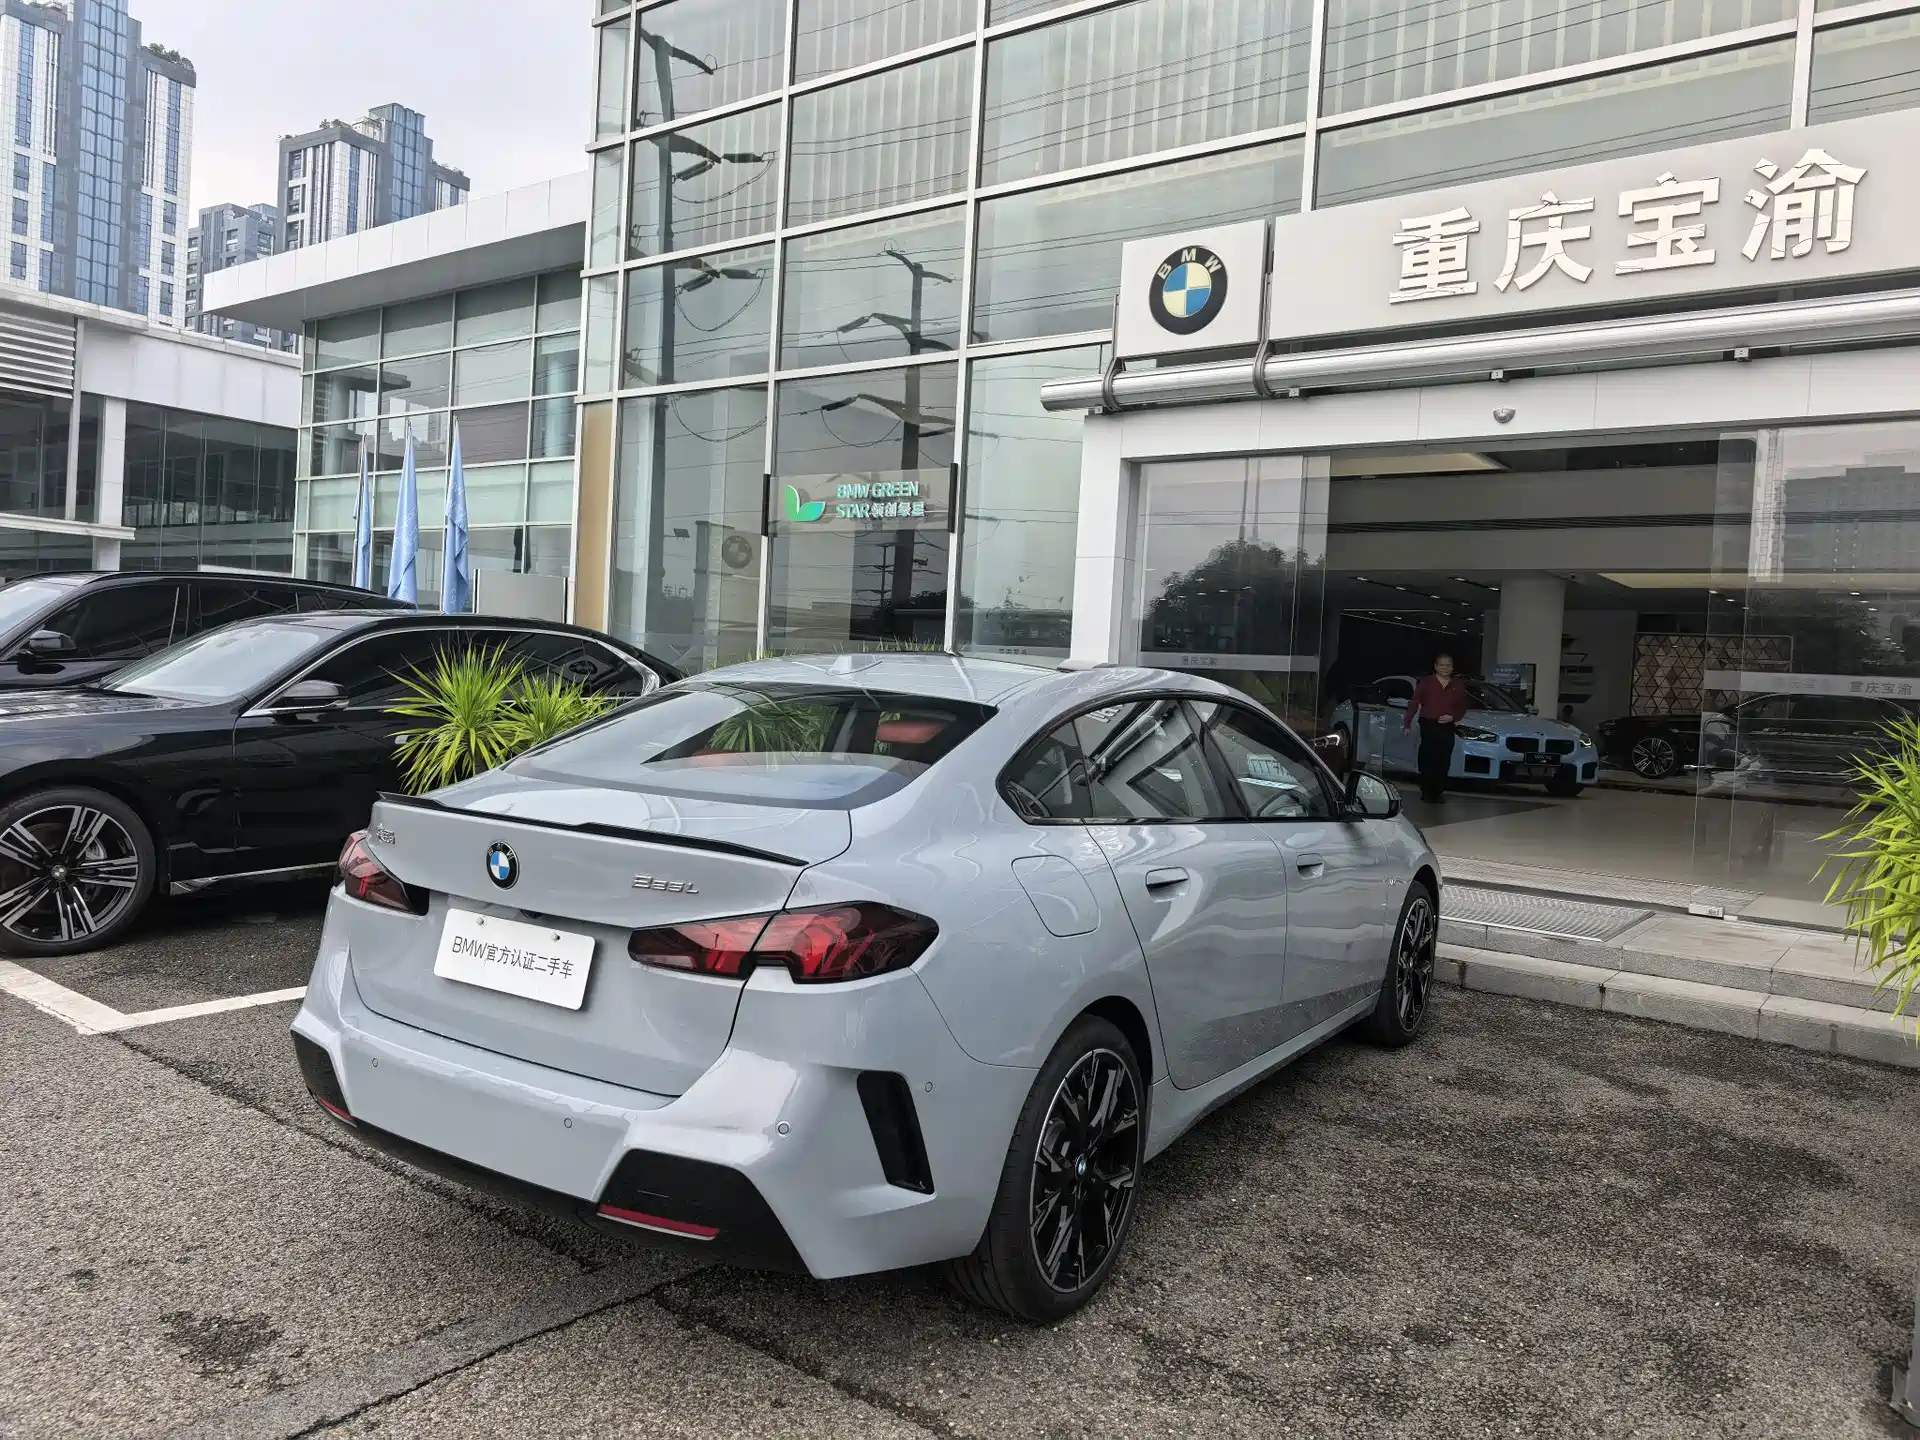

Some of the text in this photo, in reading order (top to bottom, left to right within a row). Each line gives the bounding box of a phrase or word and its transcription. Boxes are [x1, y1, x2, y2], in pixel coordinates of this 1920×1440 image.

[1388, 148, 1868, 306] 重庆宝渝
[1157, 247, 1222, 280] BMW
[836, 481, 919, 499] BMW GREEN
[836, 502, 870, 518] STAR
[1849, 680, 1913, 696] 重庆宝渝
[452, 935, 574, 979] BMW官方认证二手车
